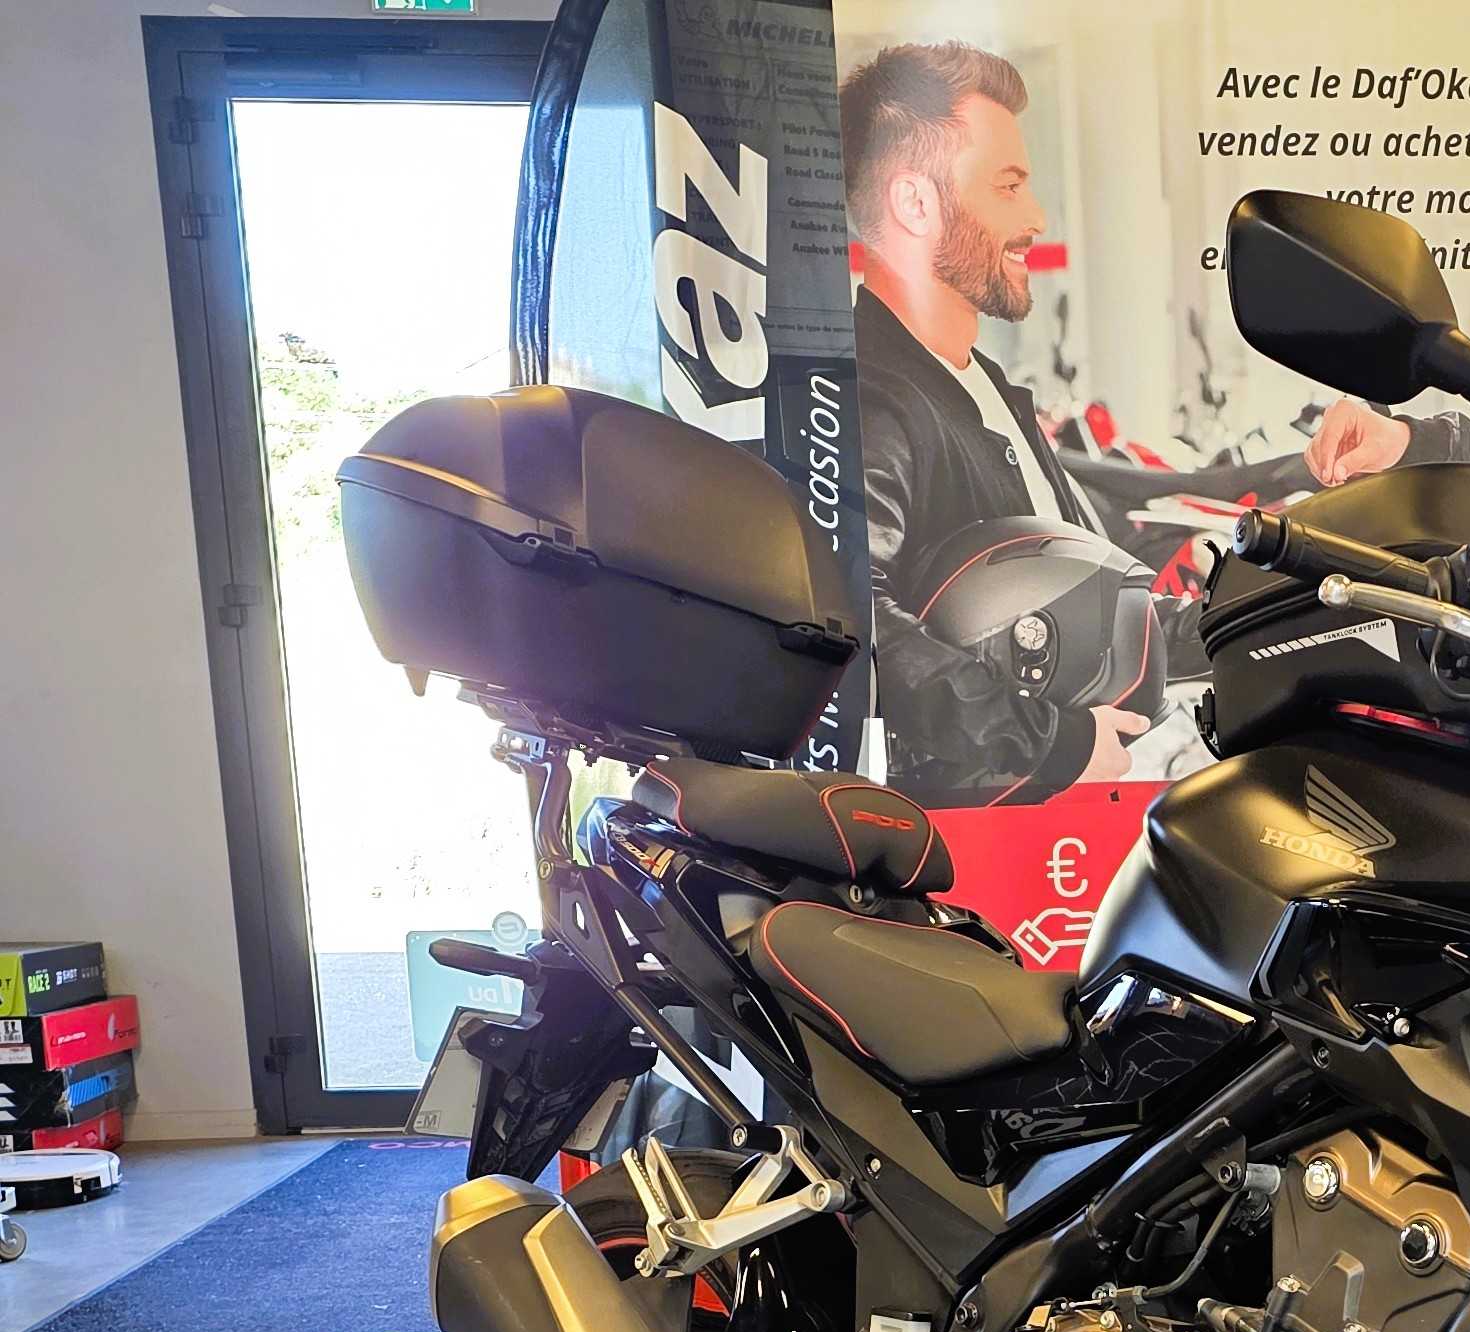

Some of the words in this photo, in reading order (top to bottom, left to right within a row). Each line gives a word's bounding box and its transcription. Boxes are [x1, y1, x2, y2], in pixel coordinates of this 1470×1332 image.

[726, 18, 837, 49] MICHELI
[1217, 66, 1300, 99] Avec
[1310, 66, 1341, 99] le
[1198, 124, 1320, 156] vendez
[1330, 132, 1372, 156] ou
[807, 374, 841, 552] casion
[1323, 627, 1357, 641] TANKLOCK
[1358, 620, 1388, 634] SYSTEM
[1259, 826, 1377, 879] HONDA
